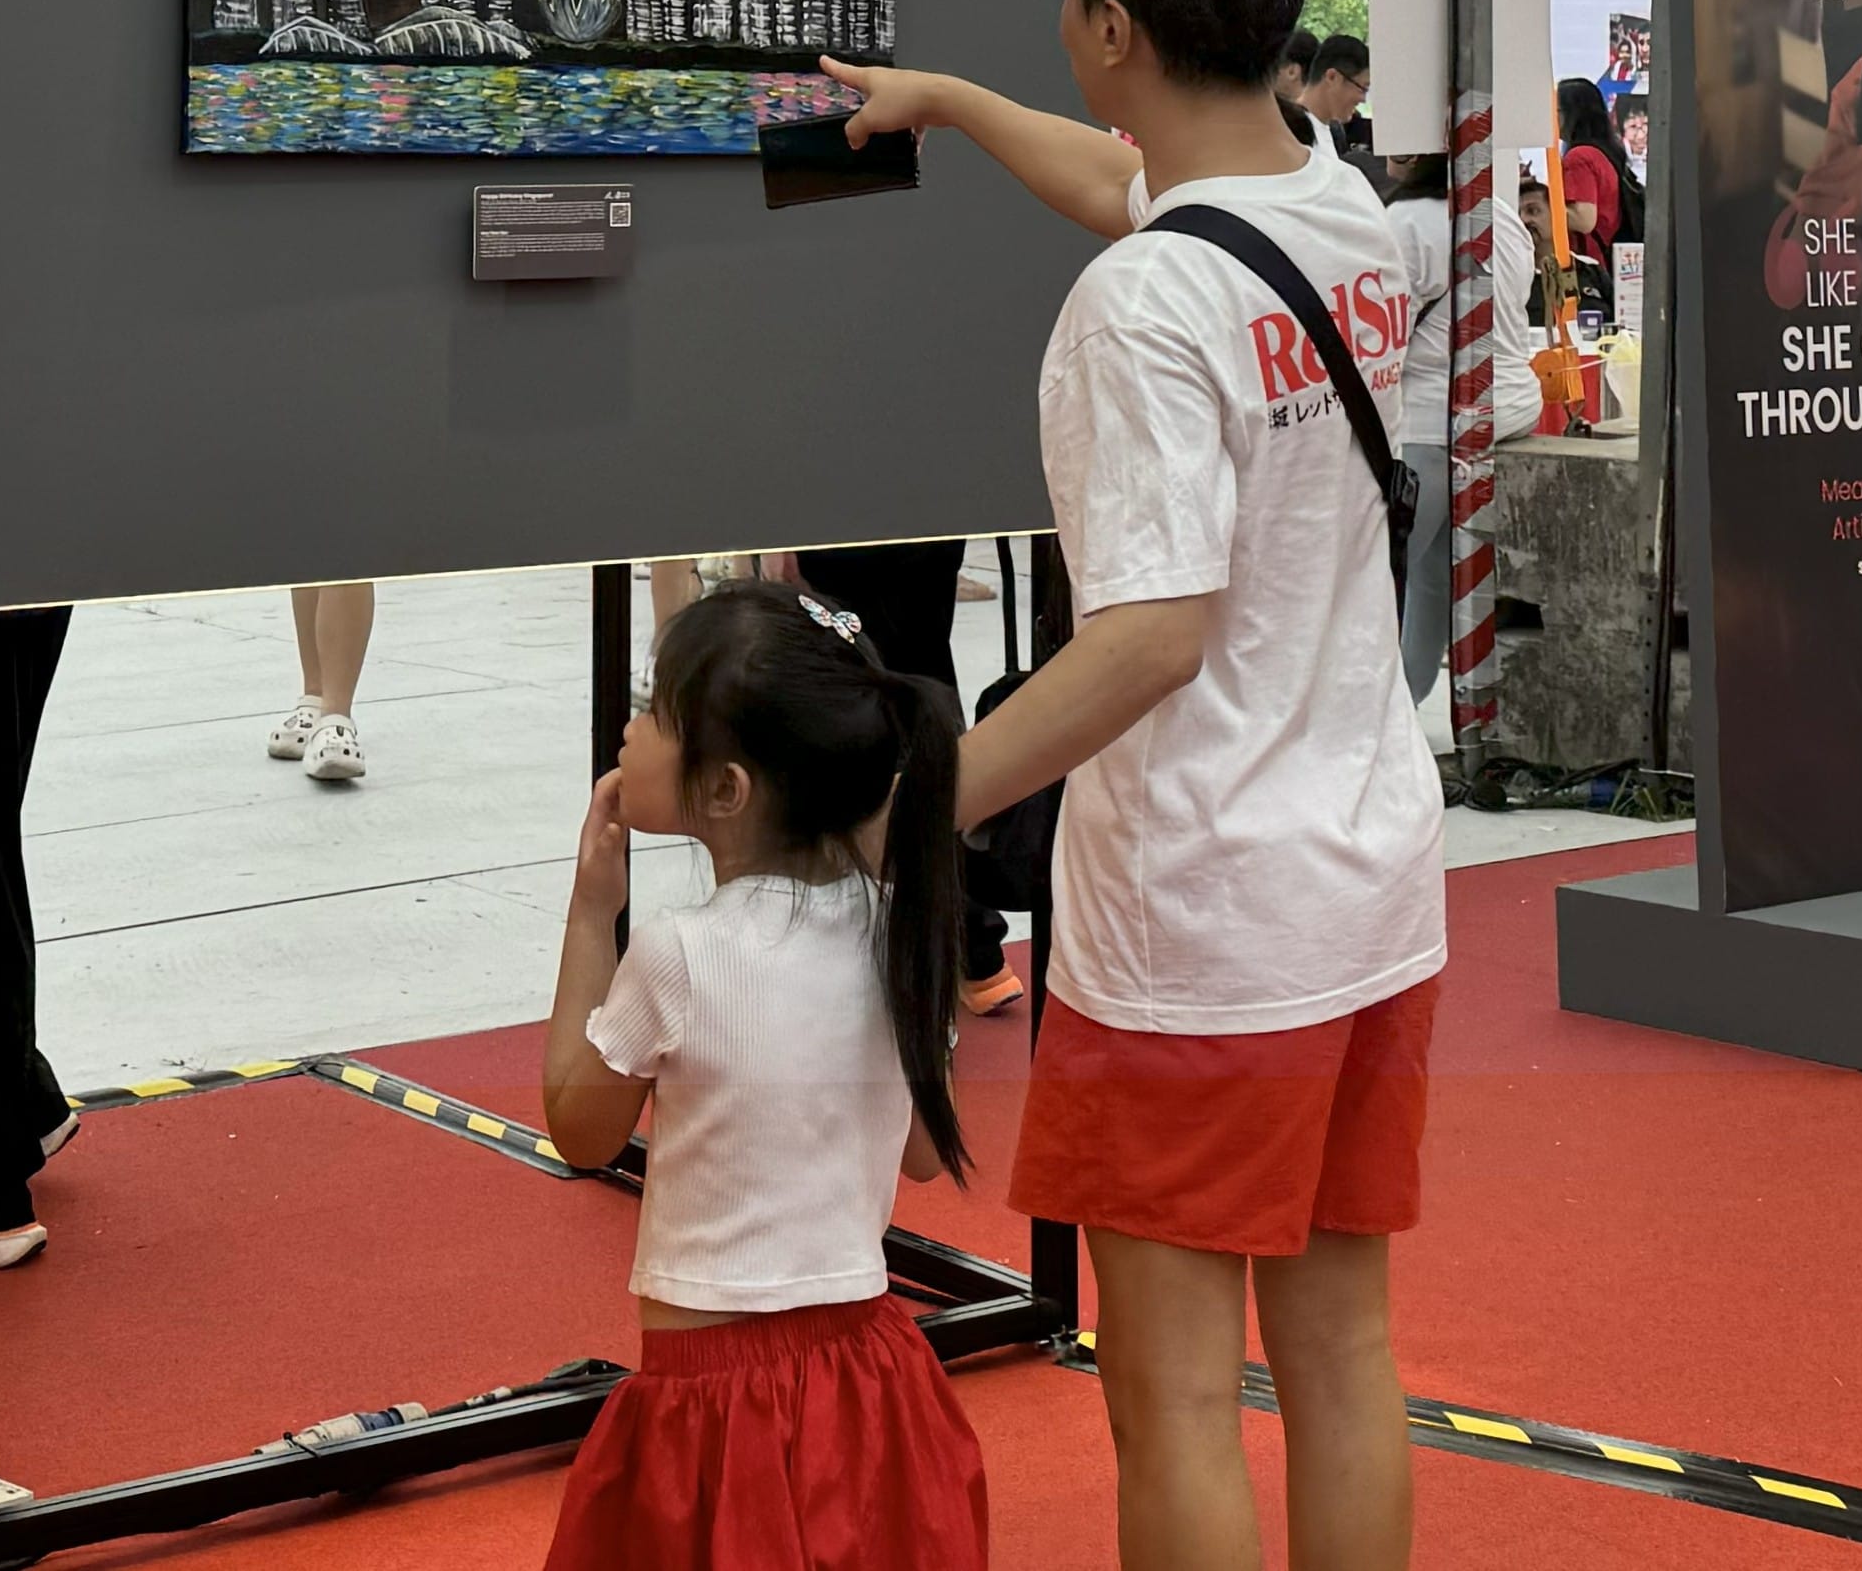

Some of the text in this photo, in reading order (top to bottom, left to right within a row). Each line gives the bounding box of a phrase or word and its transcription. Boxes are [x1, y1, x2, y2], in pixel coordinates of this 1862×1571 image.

[1803, 218, 1857, 255] SHE
[1806, 270, 1858, 308] LIKE
[1782, 325, 1853, 372] SHE
